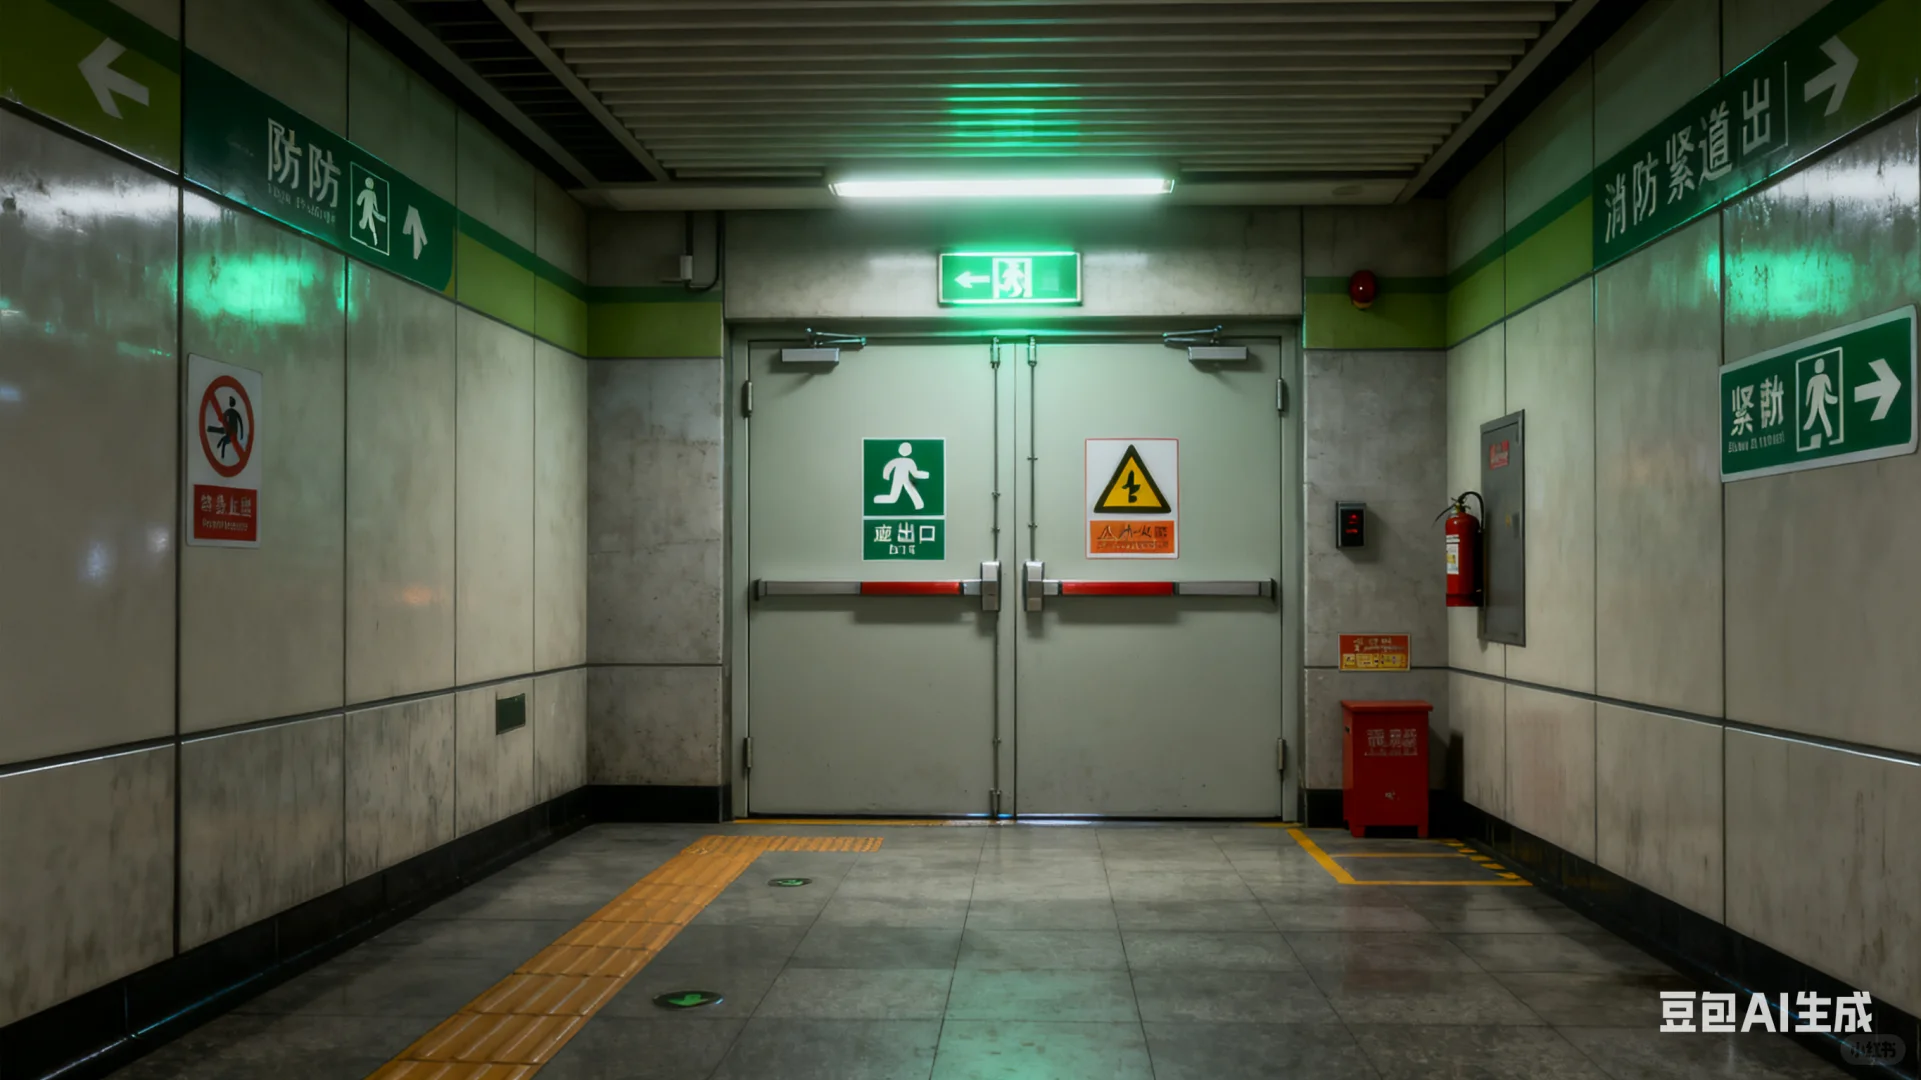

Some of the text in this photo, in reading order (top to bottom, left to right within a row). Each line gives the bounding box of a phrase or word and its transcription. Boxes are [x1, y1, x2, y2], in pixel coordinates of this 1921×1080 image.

[1605, 77, 1770, 243] 消防紧道出
